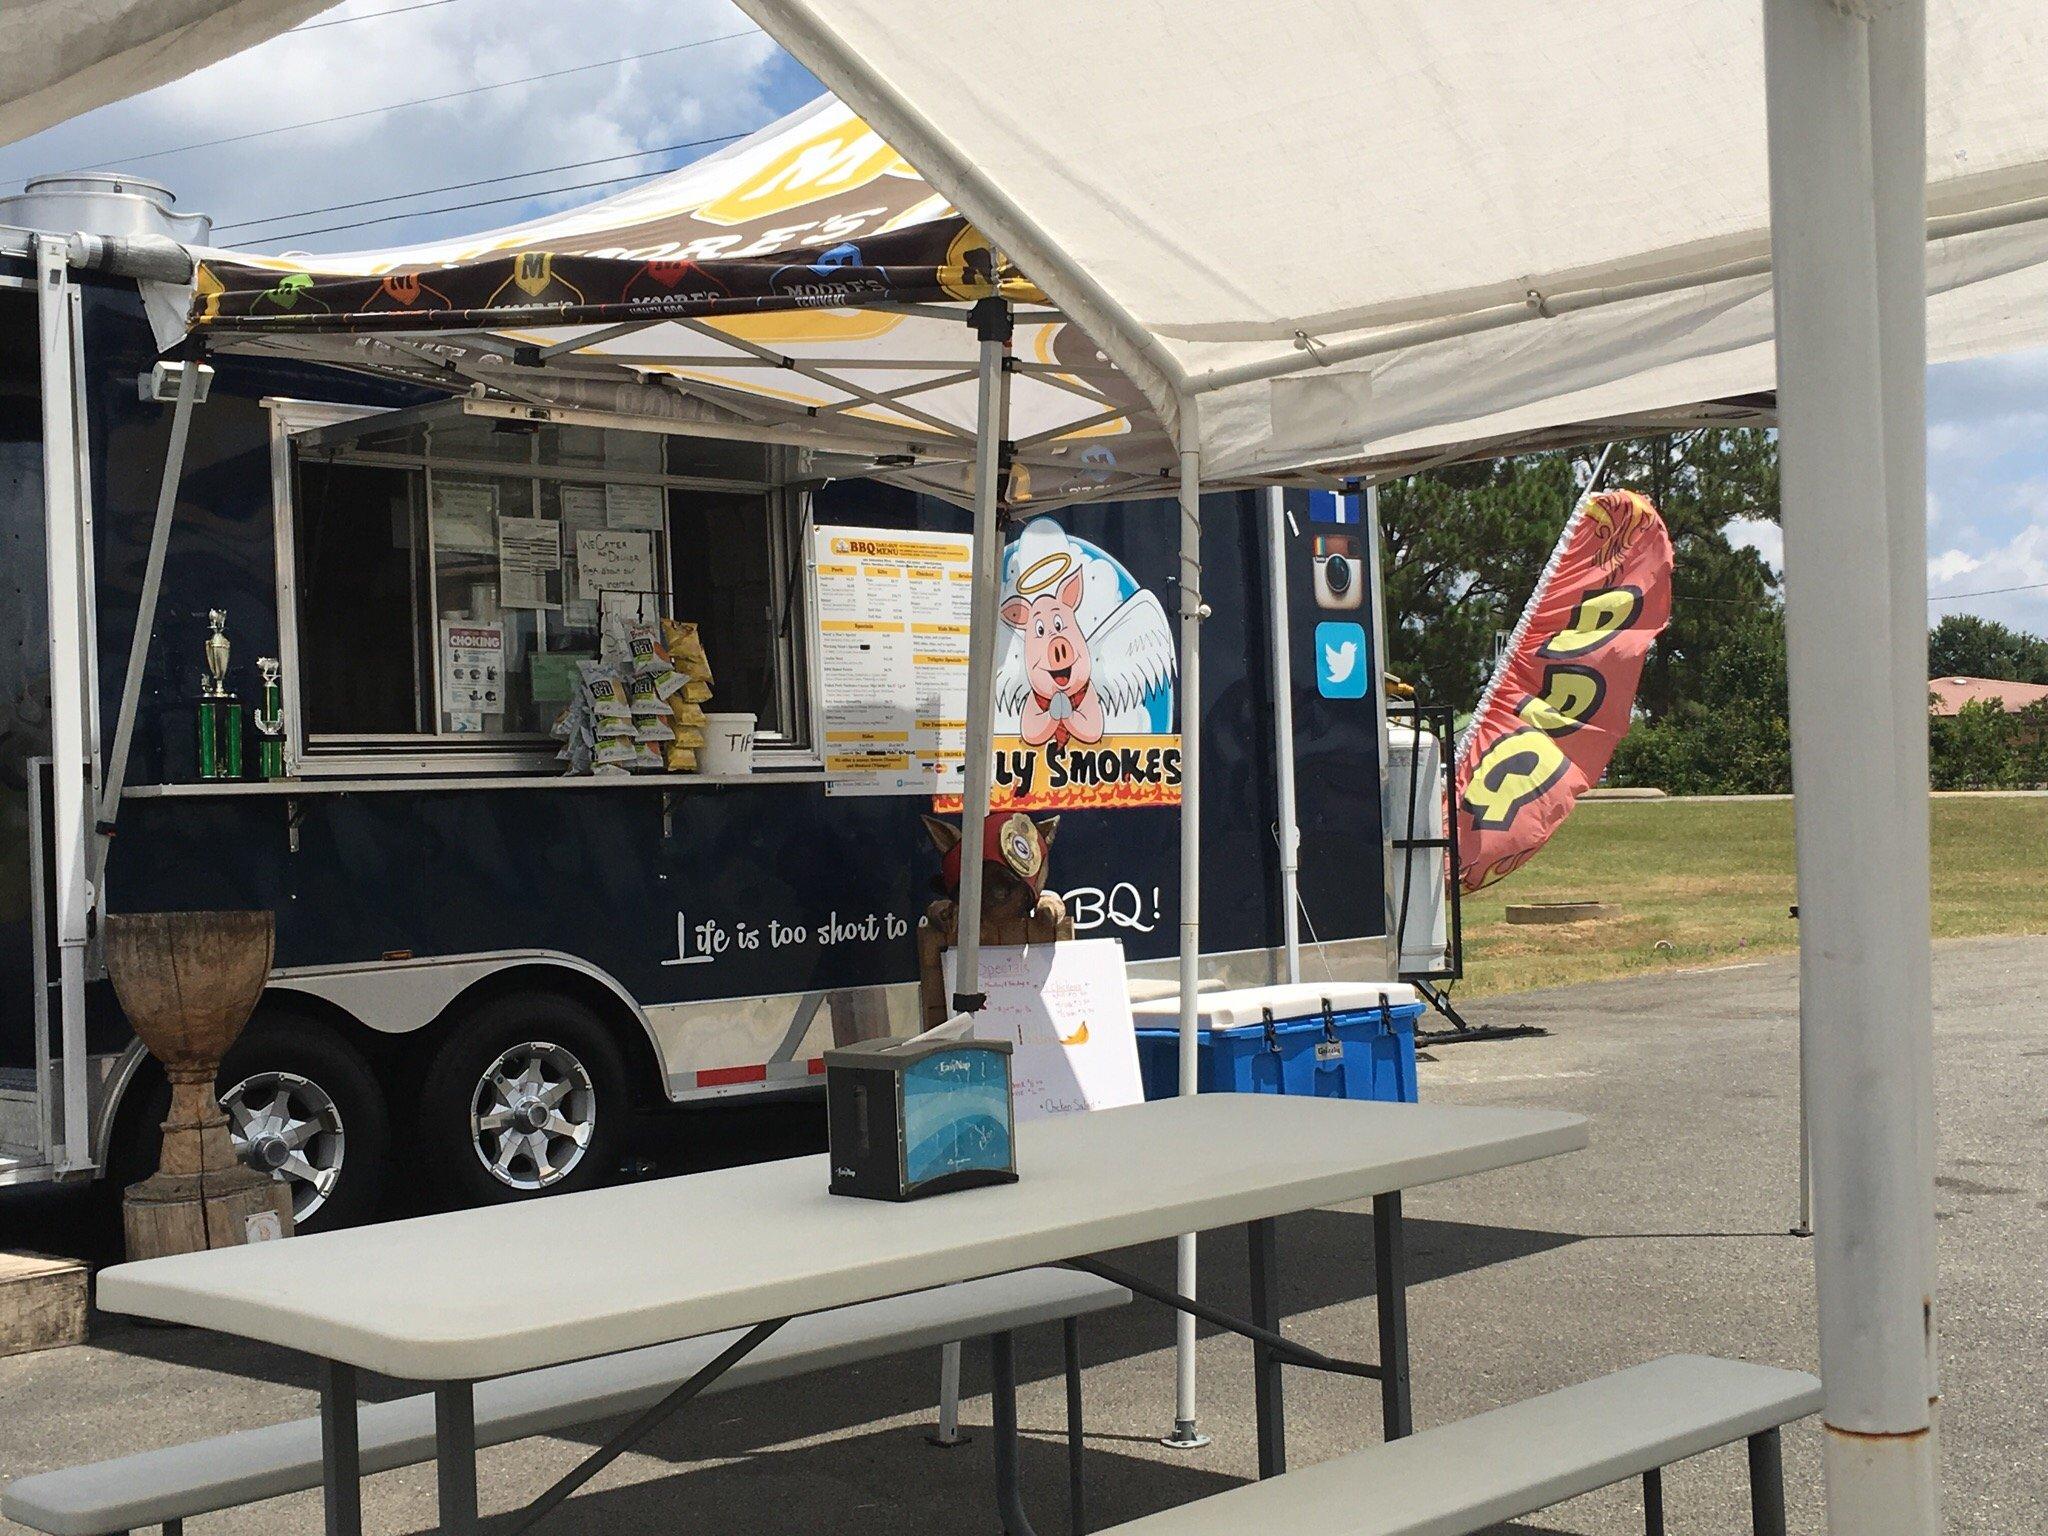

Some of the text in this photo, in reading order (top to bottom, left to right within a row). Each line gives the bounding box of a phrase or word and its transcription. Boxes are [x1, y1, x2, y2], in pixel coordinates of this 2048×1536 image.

[850, 541, 876, 555] BBQ
[875, 547, 898, 556] MENU
[450, 634, 500, 648] CHOKING
[995, 738, 1181, 799] LY SMOKES
[660, 910, 731, 967] Life
[736, 921, 760, 950] is
[768, 918, 807, 949] too
[817, 910, 880, 946] short
[884, 911, 908, 940] to
[1040, 881, 1162, 933] BQ!
